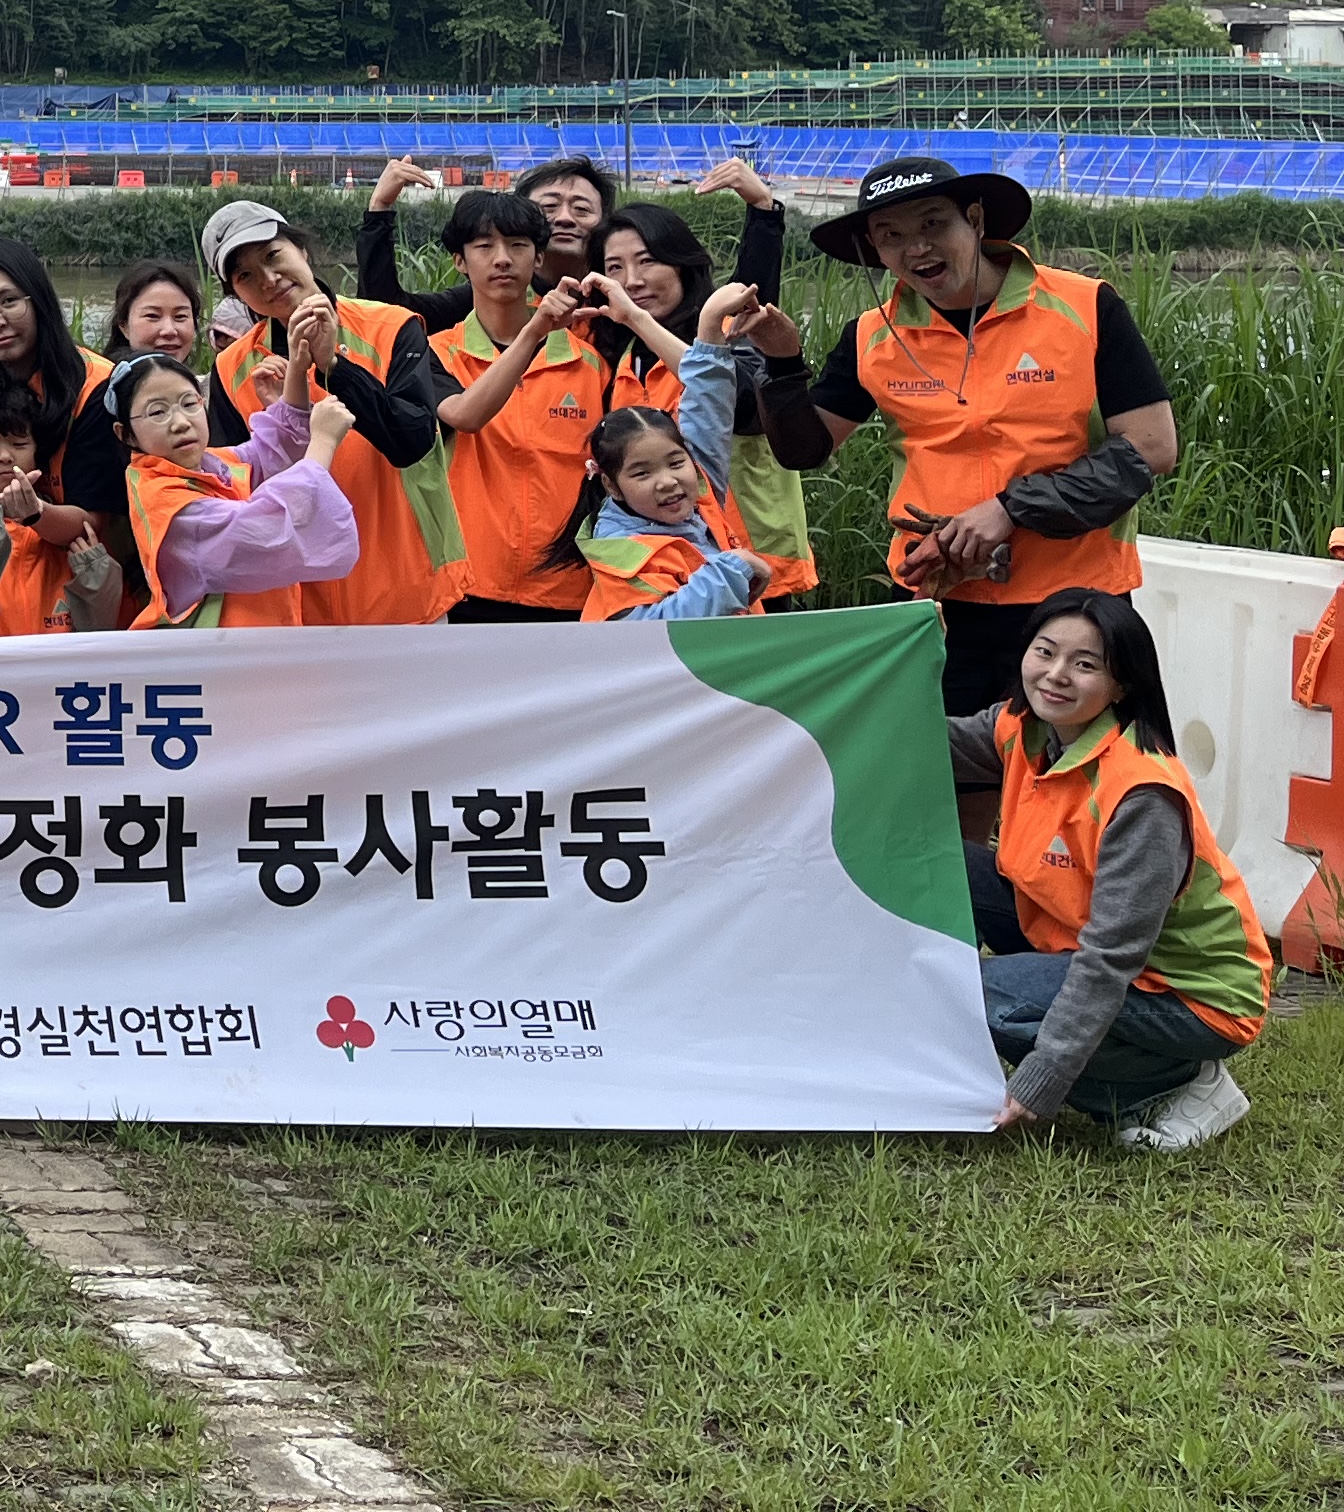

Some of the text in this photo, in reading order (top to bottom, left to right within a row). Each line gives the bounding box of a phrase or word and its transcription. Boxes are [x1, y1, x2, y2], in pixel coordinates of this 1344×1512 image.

[866, 172, 933, 200] Titleist
[1006, 369, 1056, 386] 현대건설
[52, 681, 214, 771] 활동
[237, 786, 667, 908] 봉사활동
[383, 999, 597, 1041] 사랑의열매
[454, 1045, 604, 1063] 사회복지공동모금회
